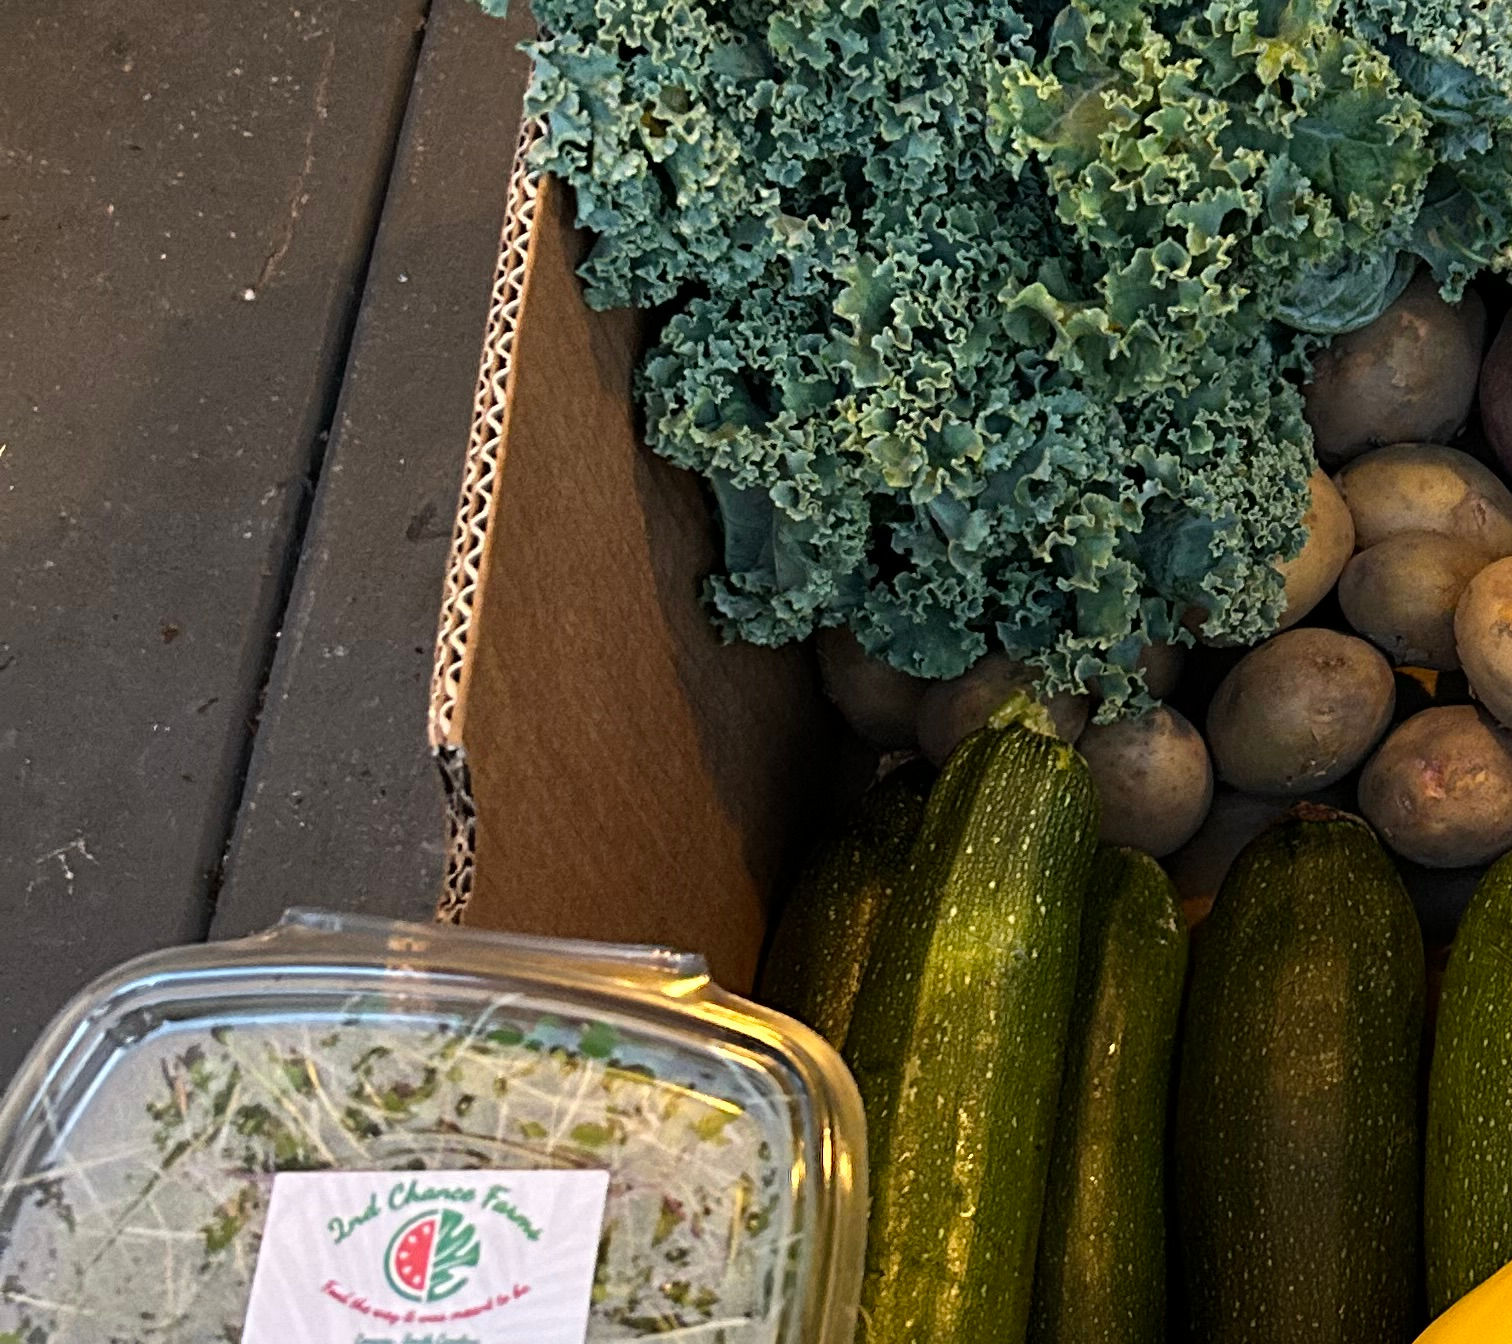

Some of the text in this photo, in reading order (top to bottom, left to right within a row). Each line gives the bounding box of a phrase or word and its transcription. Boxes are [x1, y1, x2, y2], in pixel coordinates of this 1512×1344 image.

[328, 1179, 543, 1244] 2nd Chance Farms
